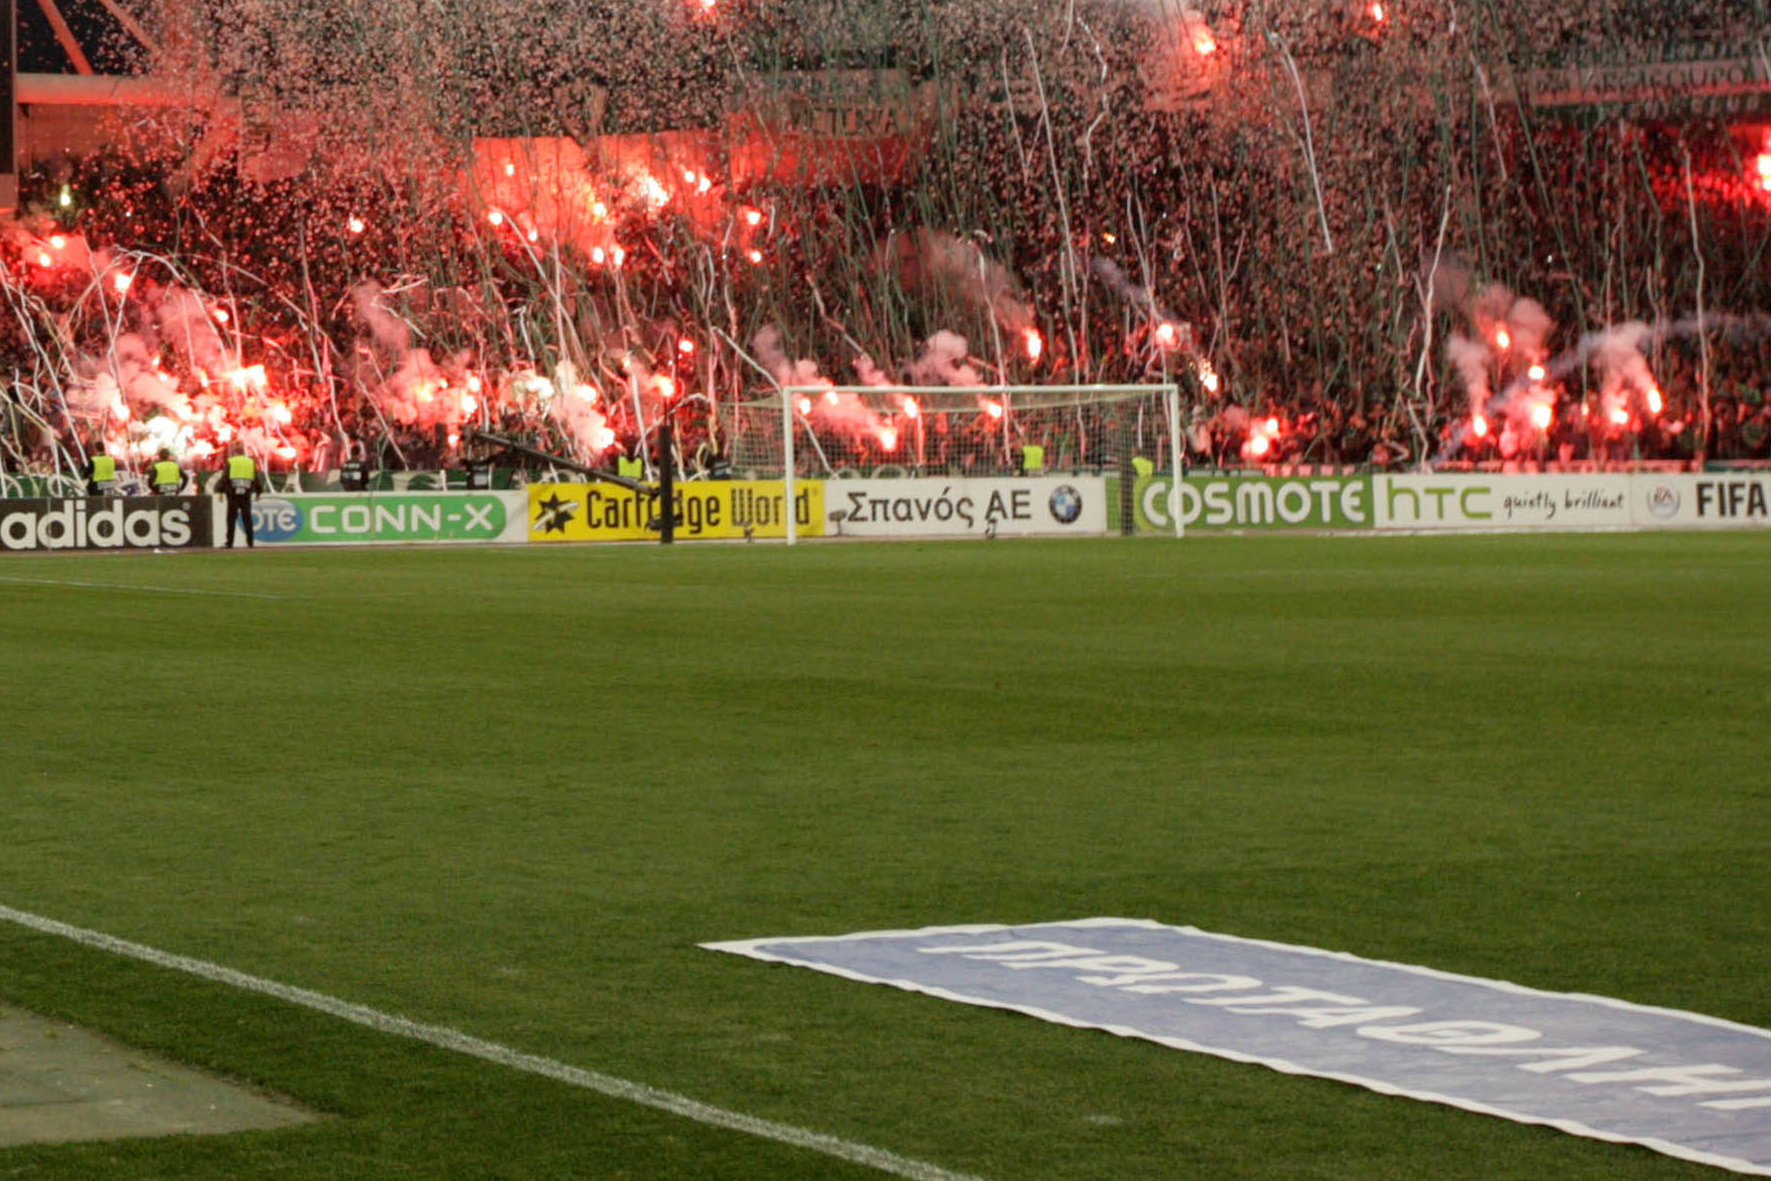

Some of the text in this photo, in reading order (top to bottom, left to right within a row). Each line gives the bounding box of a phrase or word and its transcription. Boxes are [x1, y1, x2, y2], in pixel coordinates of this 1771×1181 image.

[310, 503, 494, 534] CONN-X
[731, 487, 810, 526] Word
[847, 486, 975, 528] Σπανός
[1143, 481, 1366, 526] COSMOTE
[1503, 490, 1556, 519] quietly
[1565, 488, 1624, 509] brilliant
[1696, 482, 1768, 517] FIFA
[0, 499, 191, 549] adidas
[915, 940, 1771, 1112] ΠΡΩΤΑΘΛΗ
